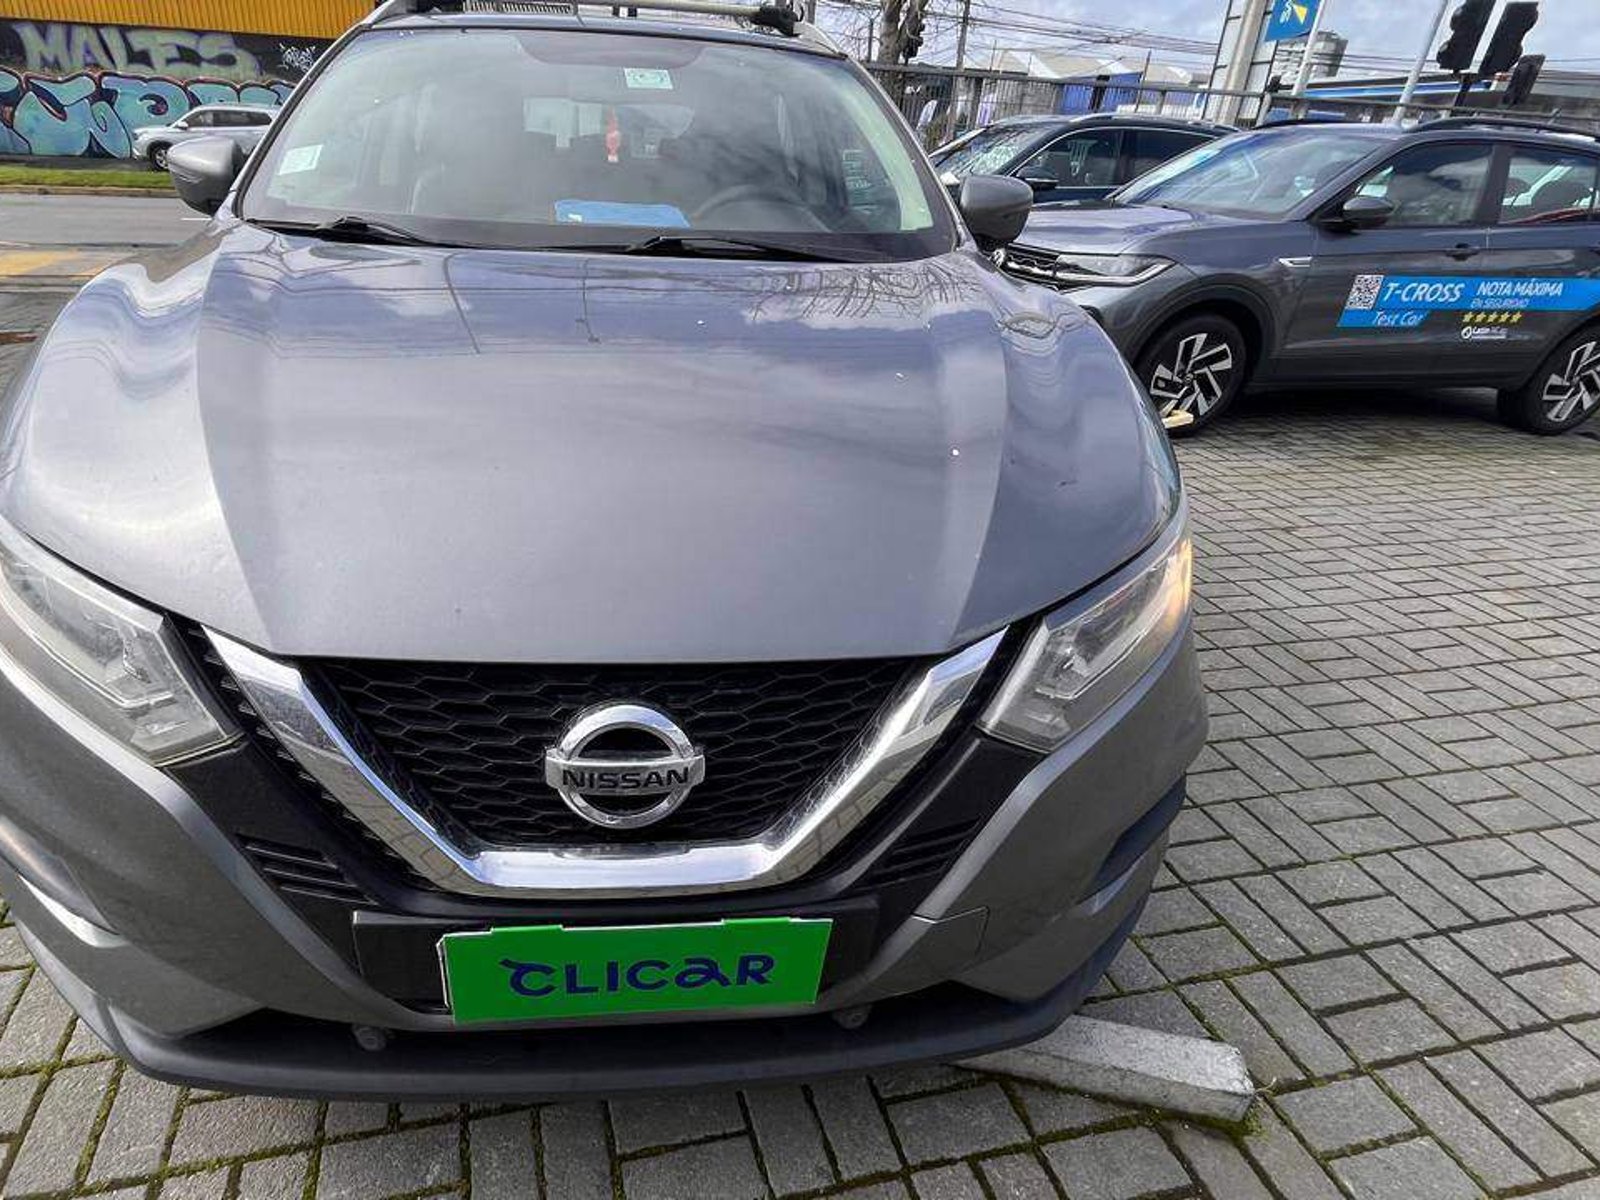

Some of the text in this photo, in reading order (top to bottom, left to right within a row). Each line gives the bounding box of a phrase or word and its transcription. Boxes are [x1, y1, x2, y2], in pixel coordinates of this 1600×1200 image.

[12, 22, 263, 78] MALES
[1384, 283, 1465, 302] T-CROSS
[1476, 278, 1564, 296] NOTA MÁXIMA
[1373, 312, 1426, 326] Test Car
[562, 767, 689, 789] NISSAN
